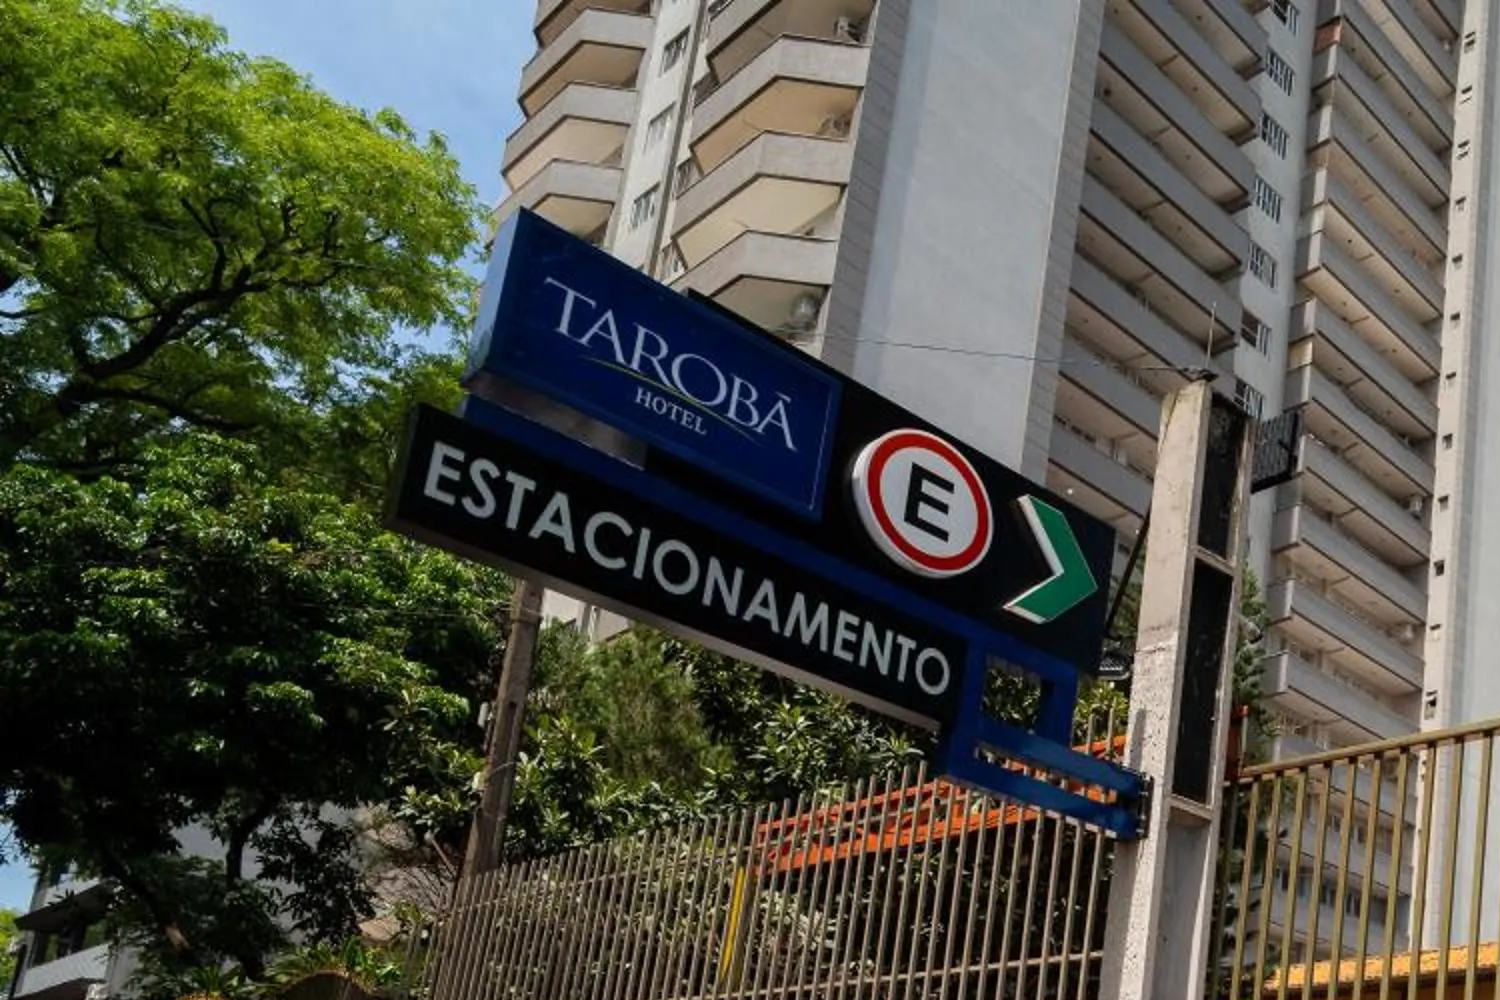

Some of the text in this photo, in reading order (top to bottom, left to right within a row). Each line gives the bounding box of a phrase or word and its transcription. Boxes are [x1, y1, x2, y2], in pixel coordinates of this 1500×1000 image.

[635, 387, 707, 436] HOTEL
[903, 462, 956, 543] E
[422, 439, 951, 697] ESTACIONAMENTO
